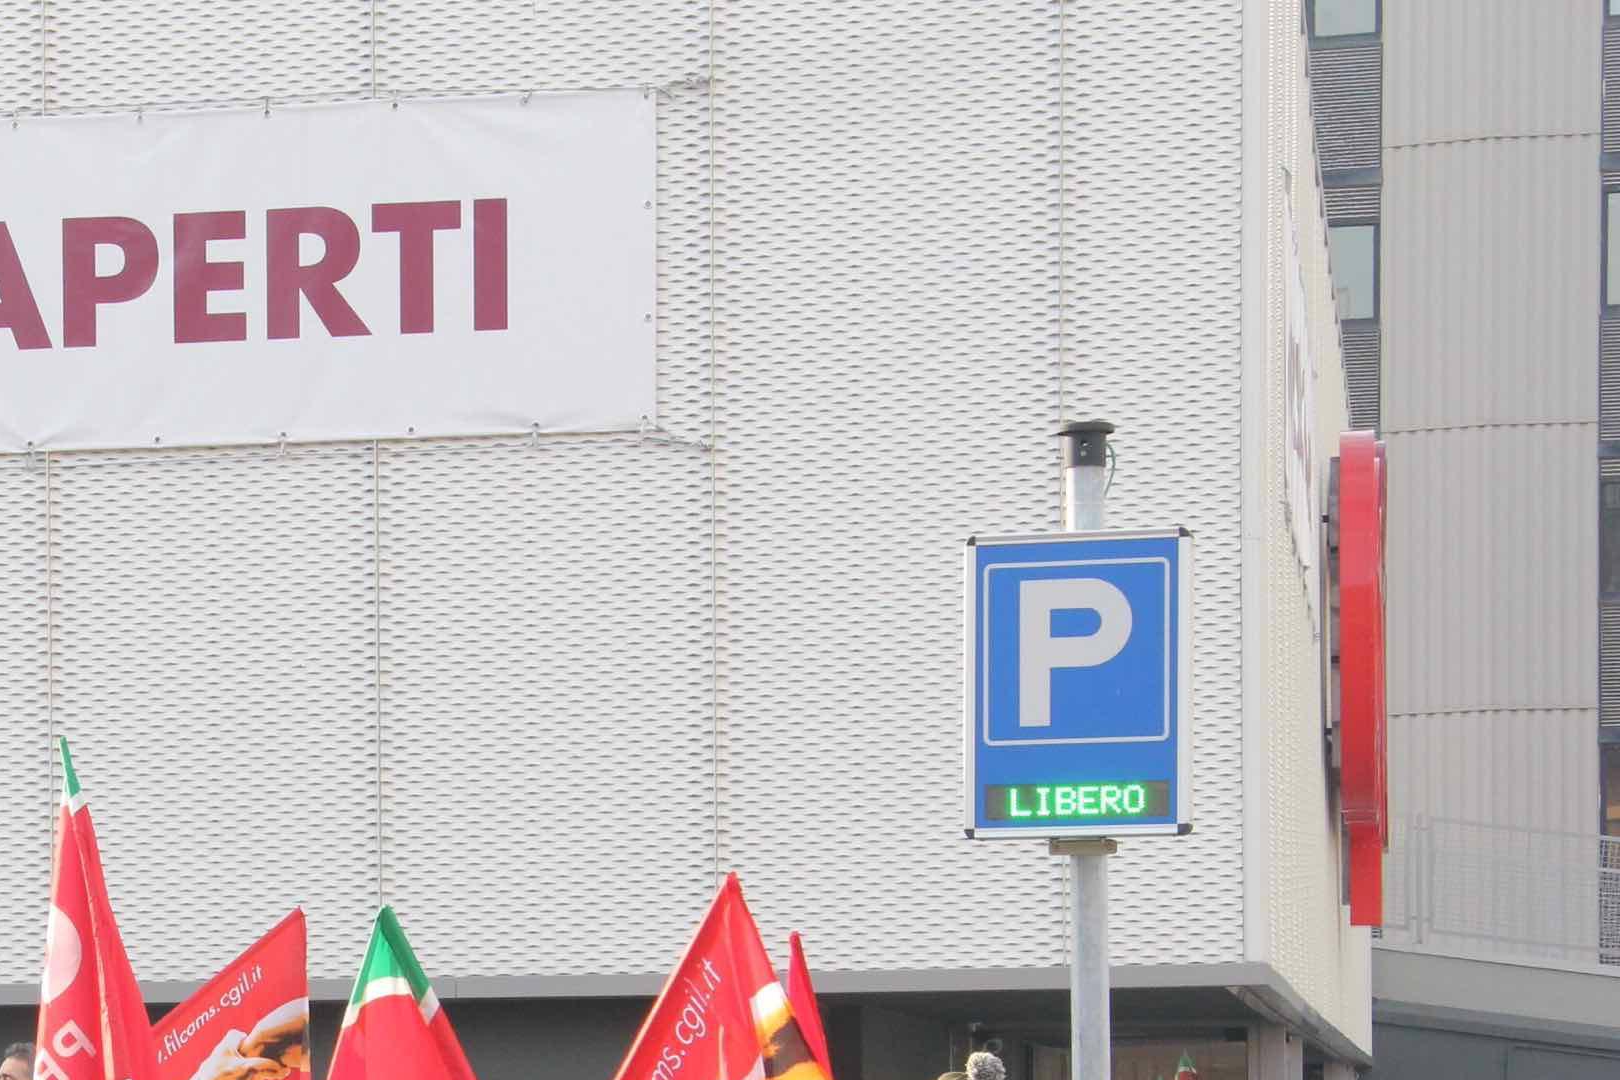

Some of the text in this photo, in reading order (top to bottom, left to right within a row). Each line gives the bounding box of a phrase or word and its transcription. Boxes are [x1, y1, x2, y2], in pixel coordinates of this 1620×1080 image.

[1019, 577, 1133, 728] P
[1008, 784, 1146, 817] LIBERO
[157, 963, 263, 1065] .filcams.cgil.it
